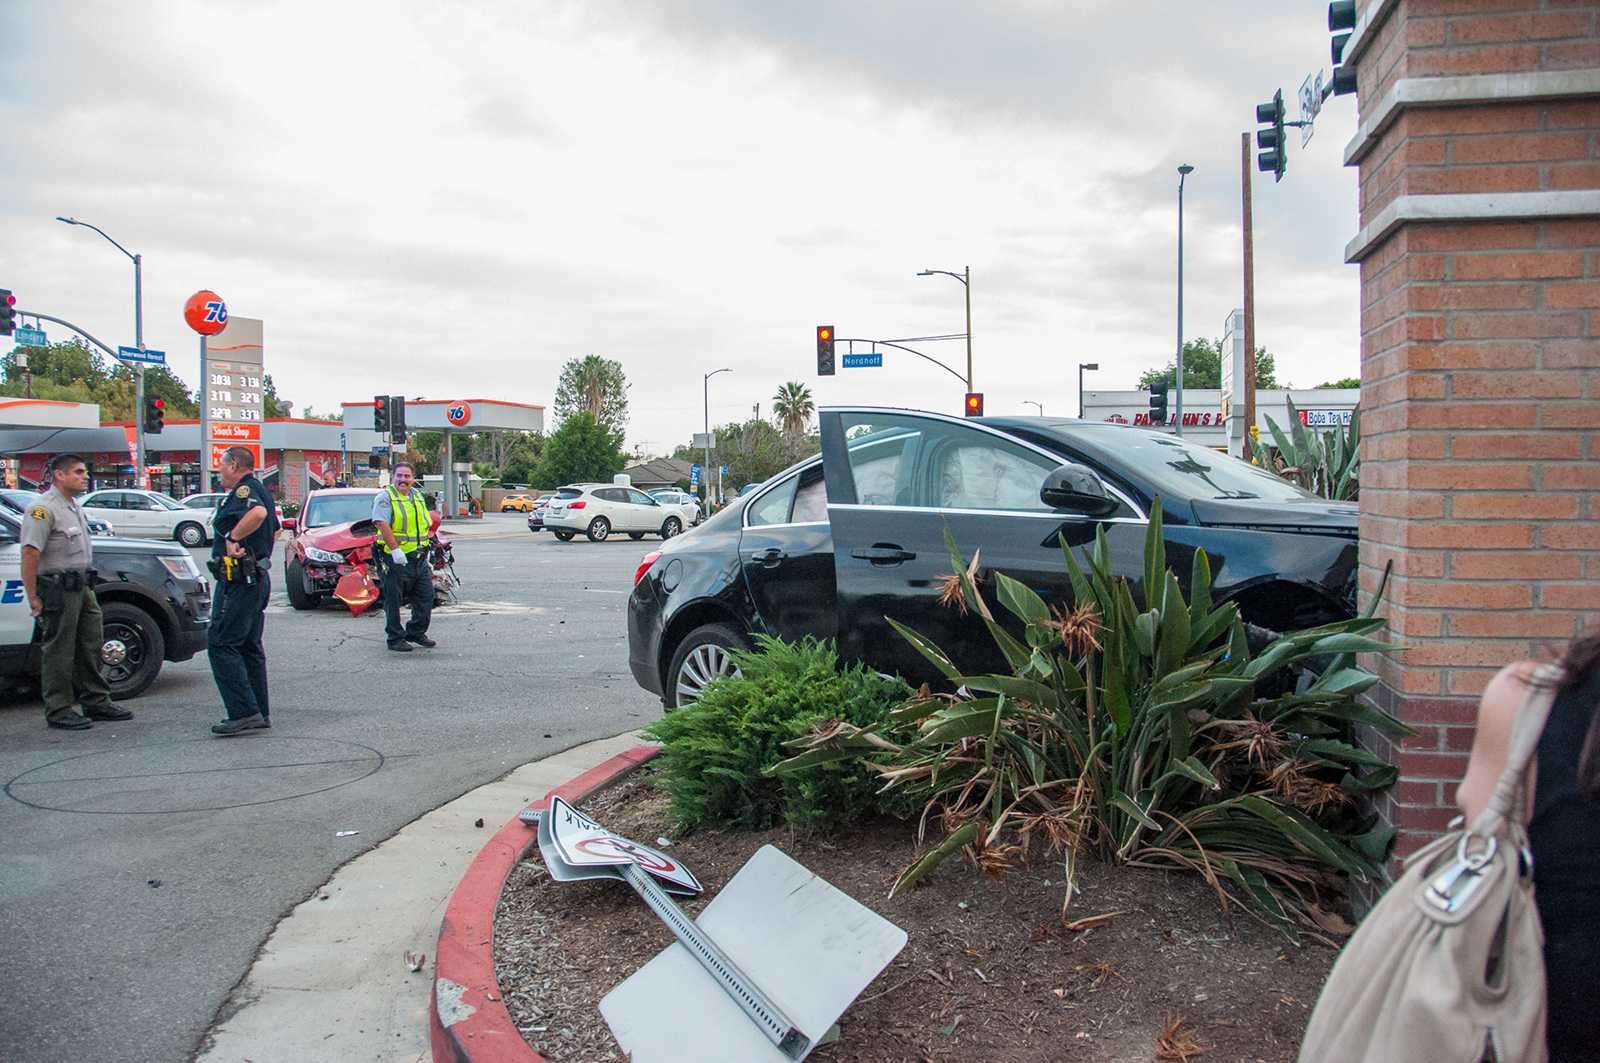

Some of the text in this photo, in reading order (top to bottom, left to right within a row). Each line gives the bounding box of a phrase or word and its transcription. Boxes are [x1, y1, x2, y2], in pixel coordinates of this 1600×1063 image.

[206, 301, 228, 323] 76
[844, 356, 880, 366] Nordhoff
[450, 405, 464, 419] 76
[1309, 412, 1325, 424] Boba
[1170, 413, 1210, 426] JHN'S
[213, 425, 250, 438] Snack Shop
